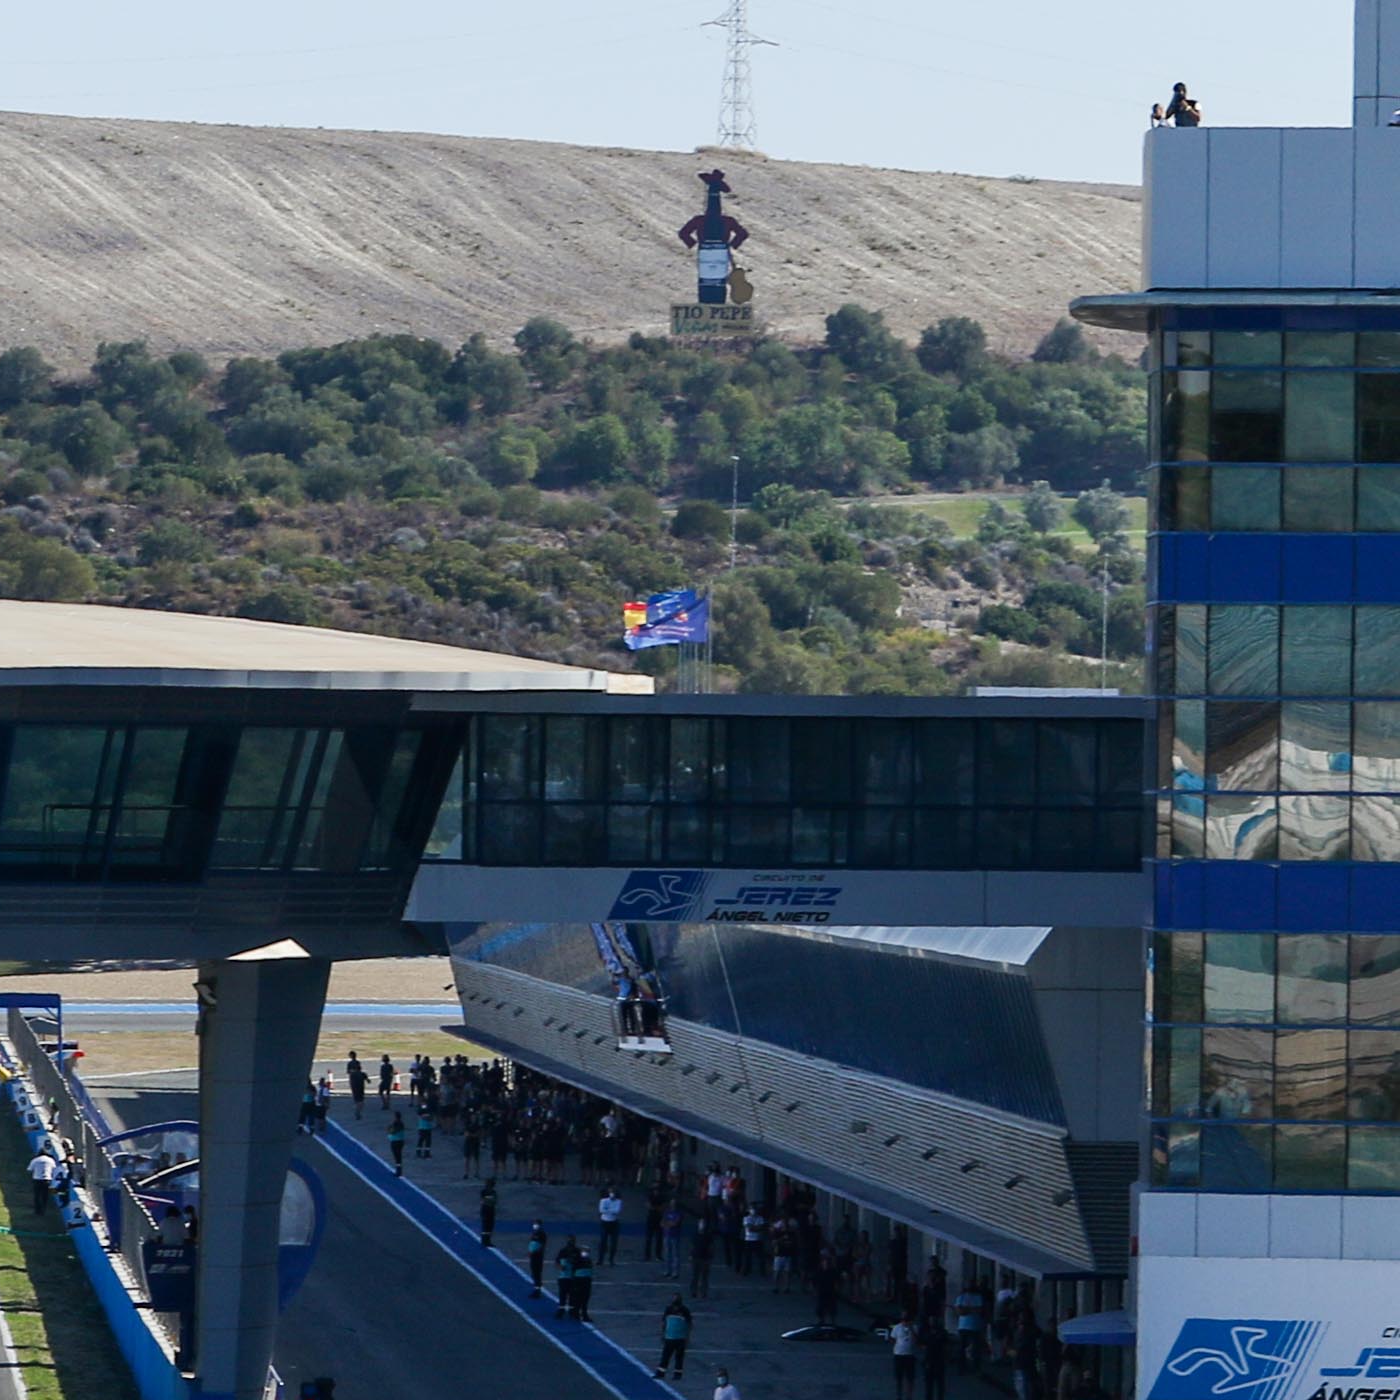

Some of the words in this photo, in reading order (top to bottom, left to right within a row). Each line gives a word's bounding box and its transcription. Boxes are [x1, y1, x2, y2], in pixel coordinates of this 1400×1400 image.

[672, 306, 703, 319] TIO
[709, 306, 753, 320] PEPE
[714, 886, 842, 906] JEREZ
[705, 908, 768, 922] ÁNGEL
[772, 911, 830, 923] NIETO
[73, 1207, 82, 1219] 2
